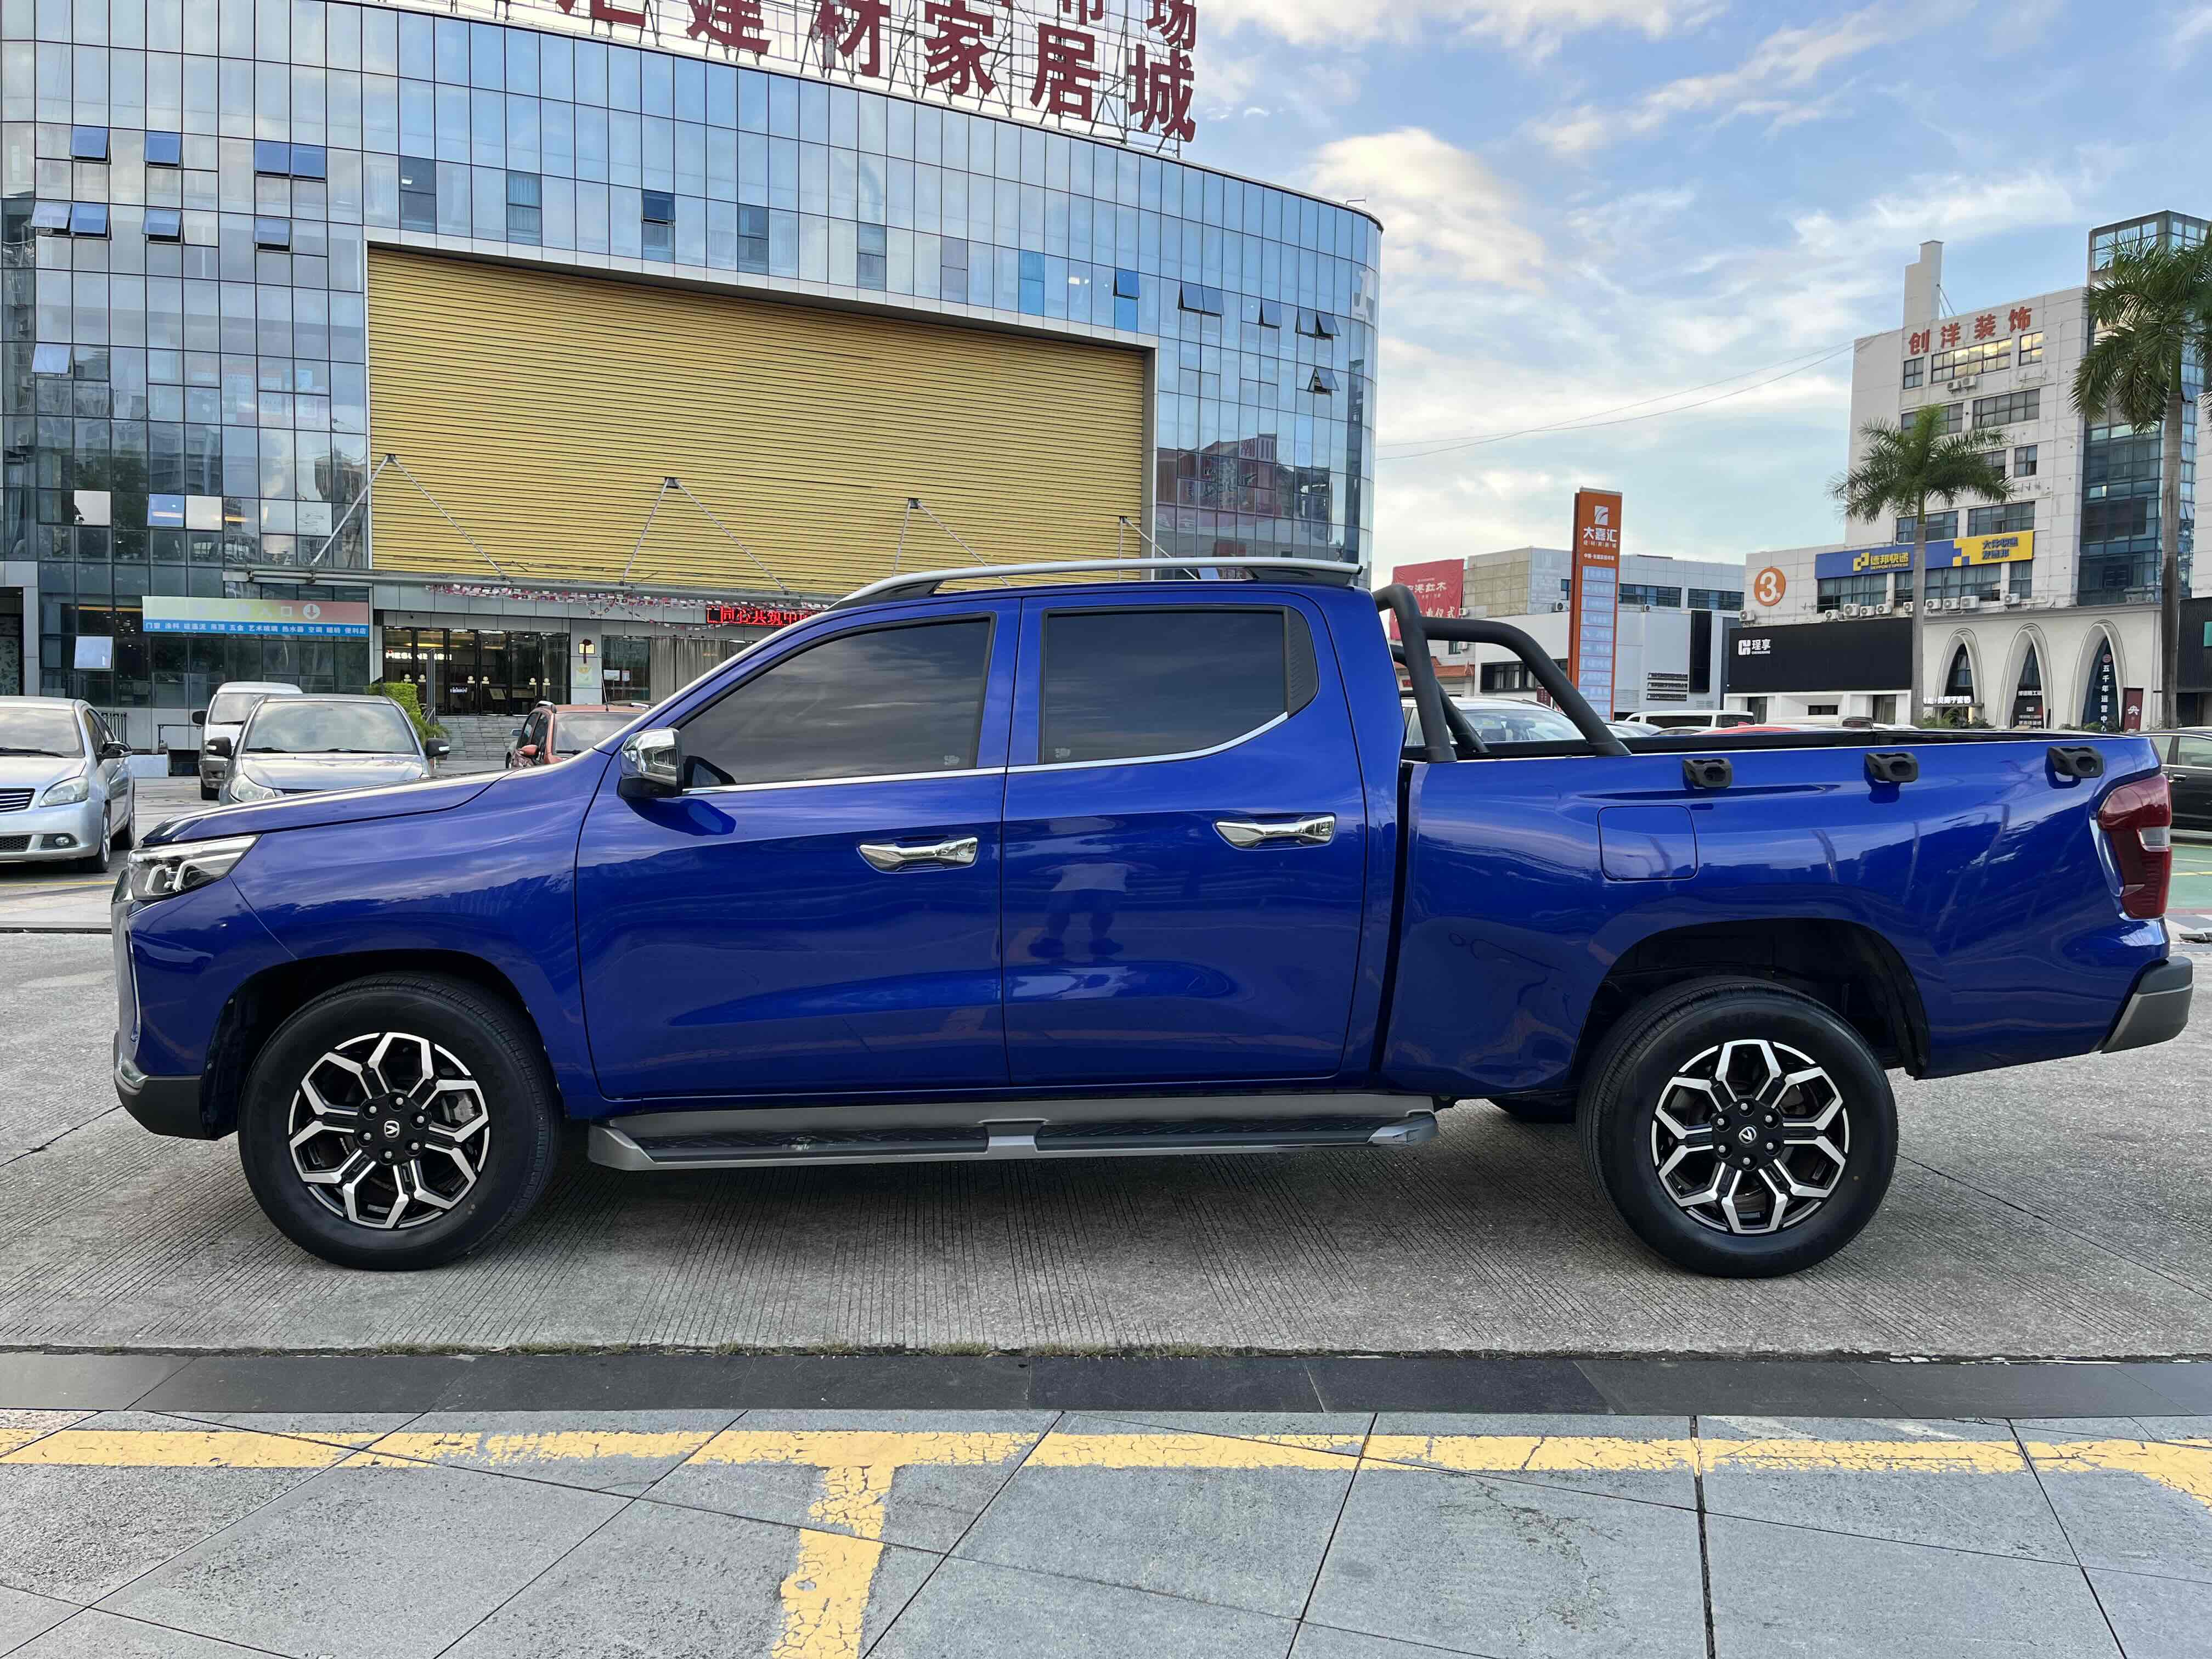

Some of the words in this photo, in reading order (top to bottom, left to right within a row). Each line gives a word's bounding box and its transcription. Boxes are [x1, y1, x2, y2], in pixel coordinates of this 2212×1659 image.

[1908, 306, 2033, 356] 创洋装饰
[1870, 552, 1909, 565] 德邦快递
